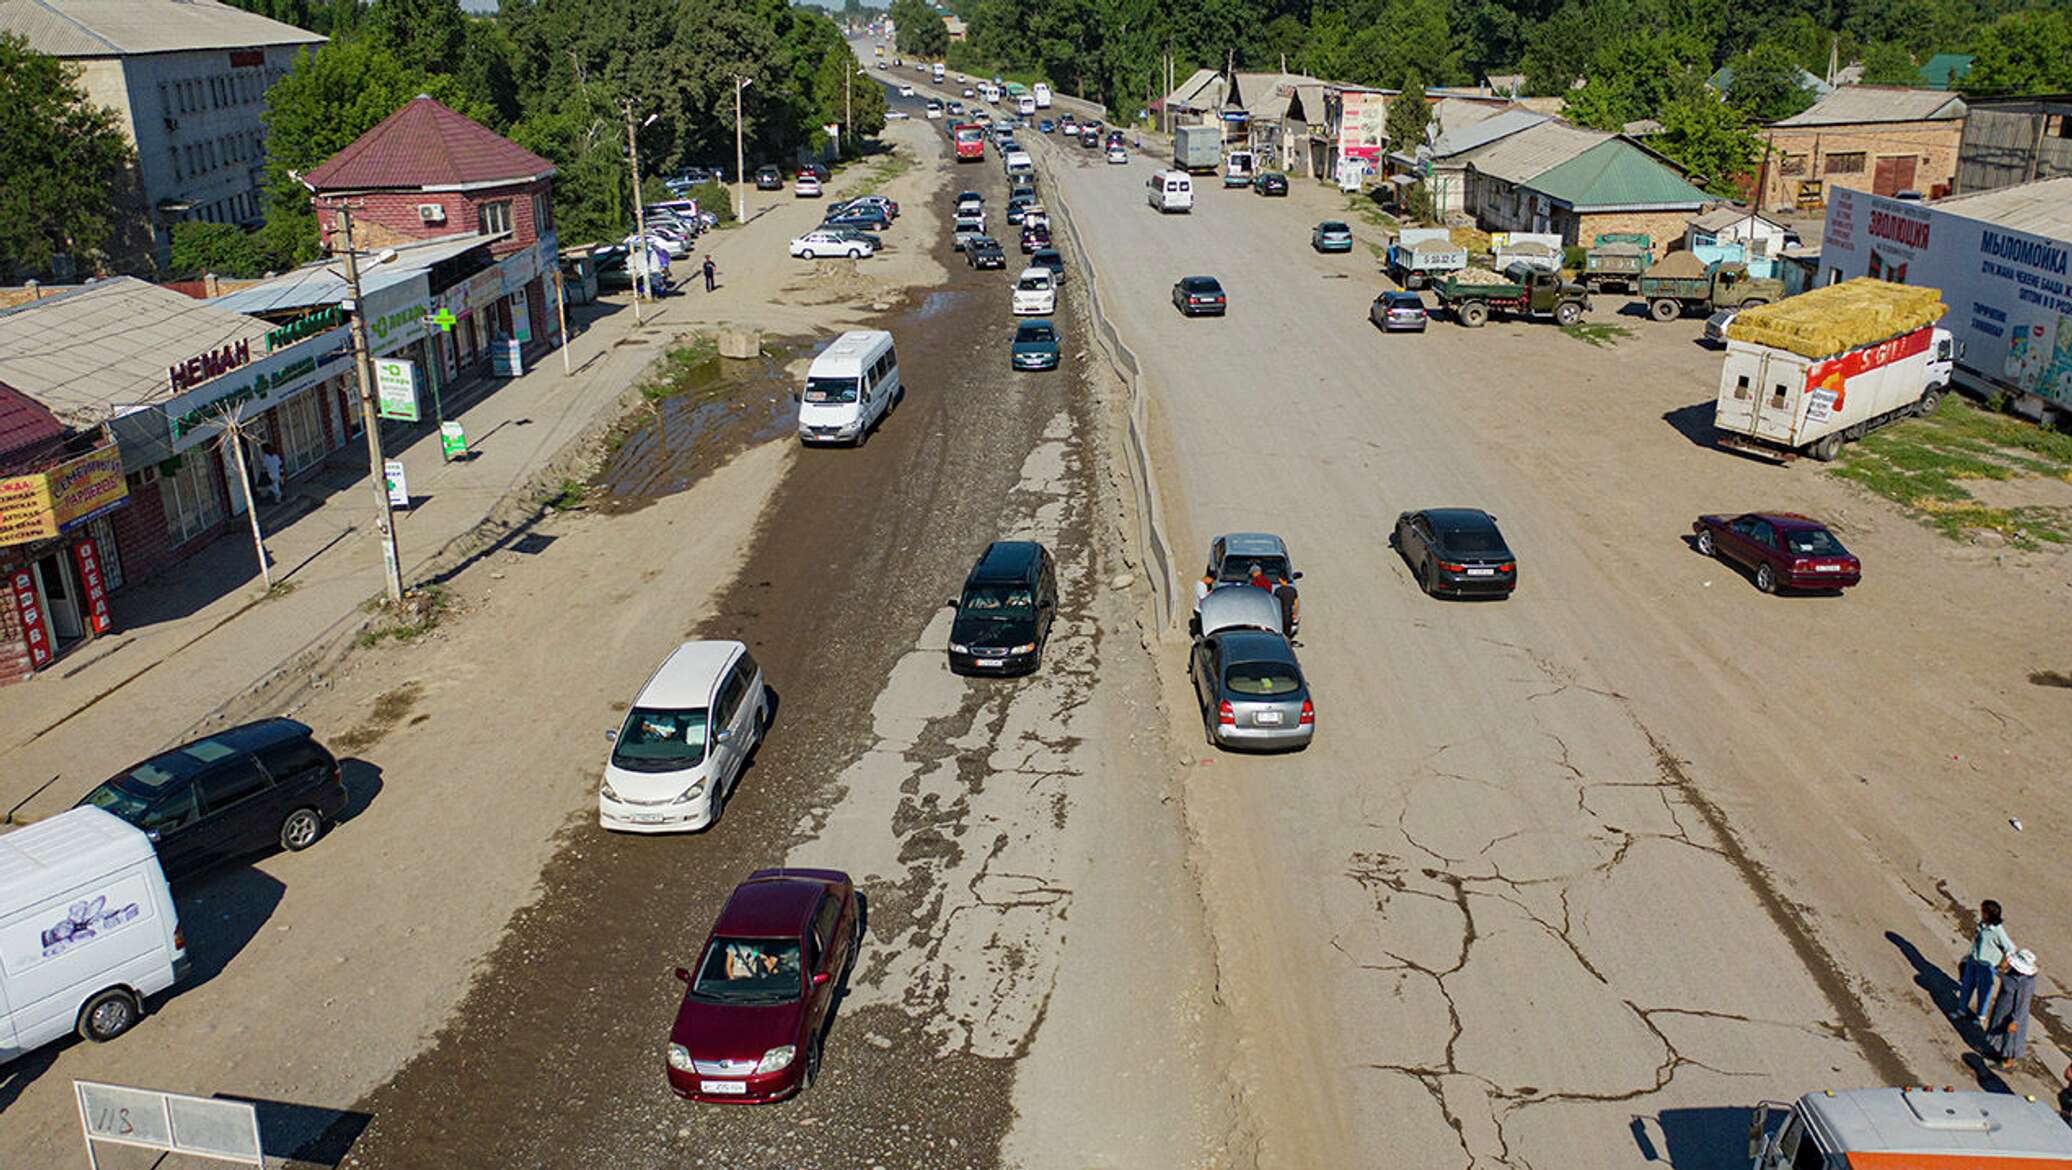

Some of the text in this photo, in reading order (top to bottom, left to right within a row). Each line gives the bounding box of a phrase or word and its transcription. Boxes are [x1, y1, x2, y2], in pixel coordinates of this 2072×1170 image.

[1867, 209, 1930, 251] ЭВОЛЮЦИЯ
[1980, 230, 2067, 276] МЫЛОМОЙКА
[168, 337, 250, 394] НЕМАН
[80, 544, 111, 628] ОДЕЖДА
[15, 573, 46, 662] ОБУВЬ
